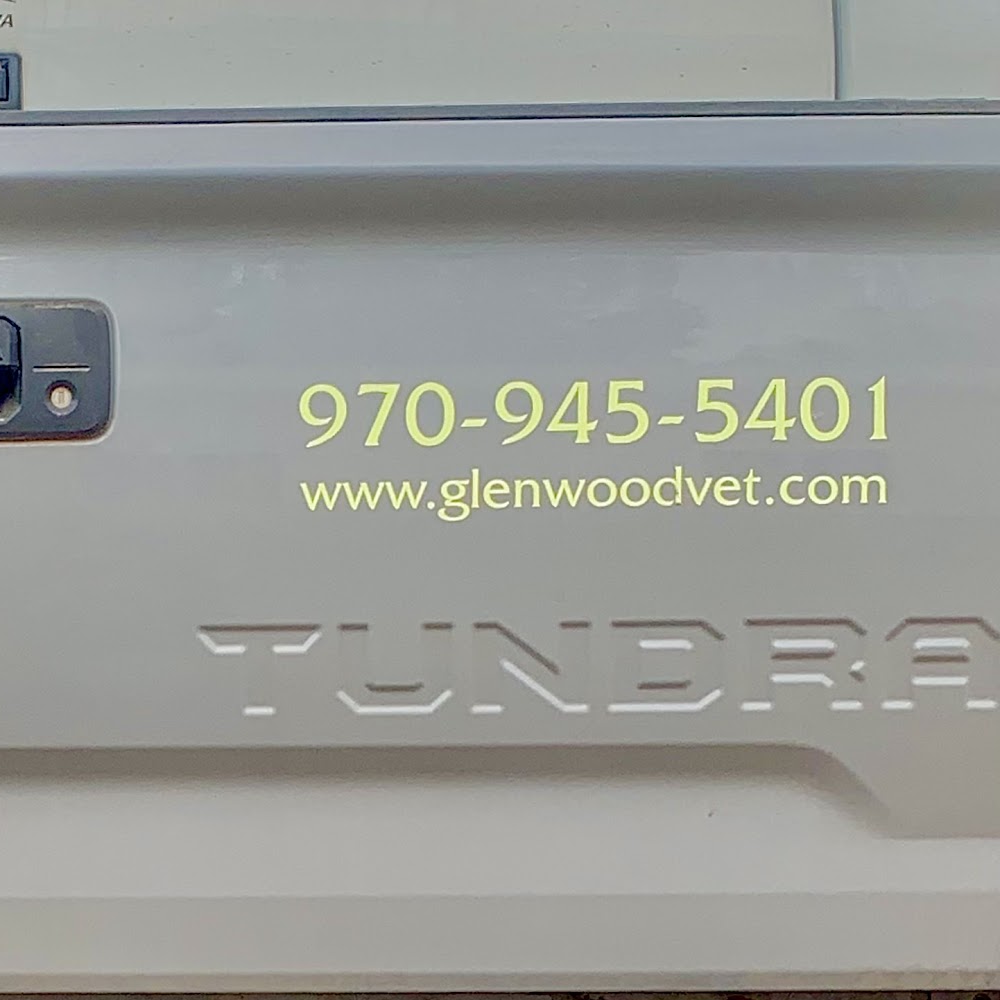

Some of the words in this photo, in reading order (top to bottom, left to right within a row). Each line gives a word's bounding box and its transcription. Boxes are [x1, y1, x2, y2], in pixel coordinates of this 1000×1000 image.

[299, 375, 889, 448] 970-945-5401
[300, 466, 889, 521] www.glenwoodvet.com
[198, 616, 1000, 717] TUNDRA
